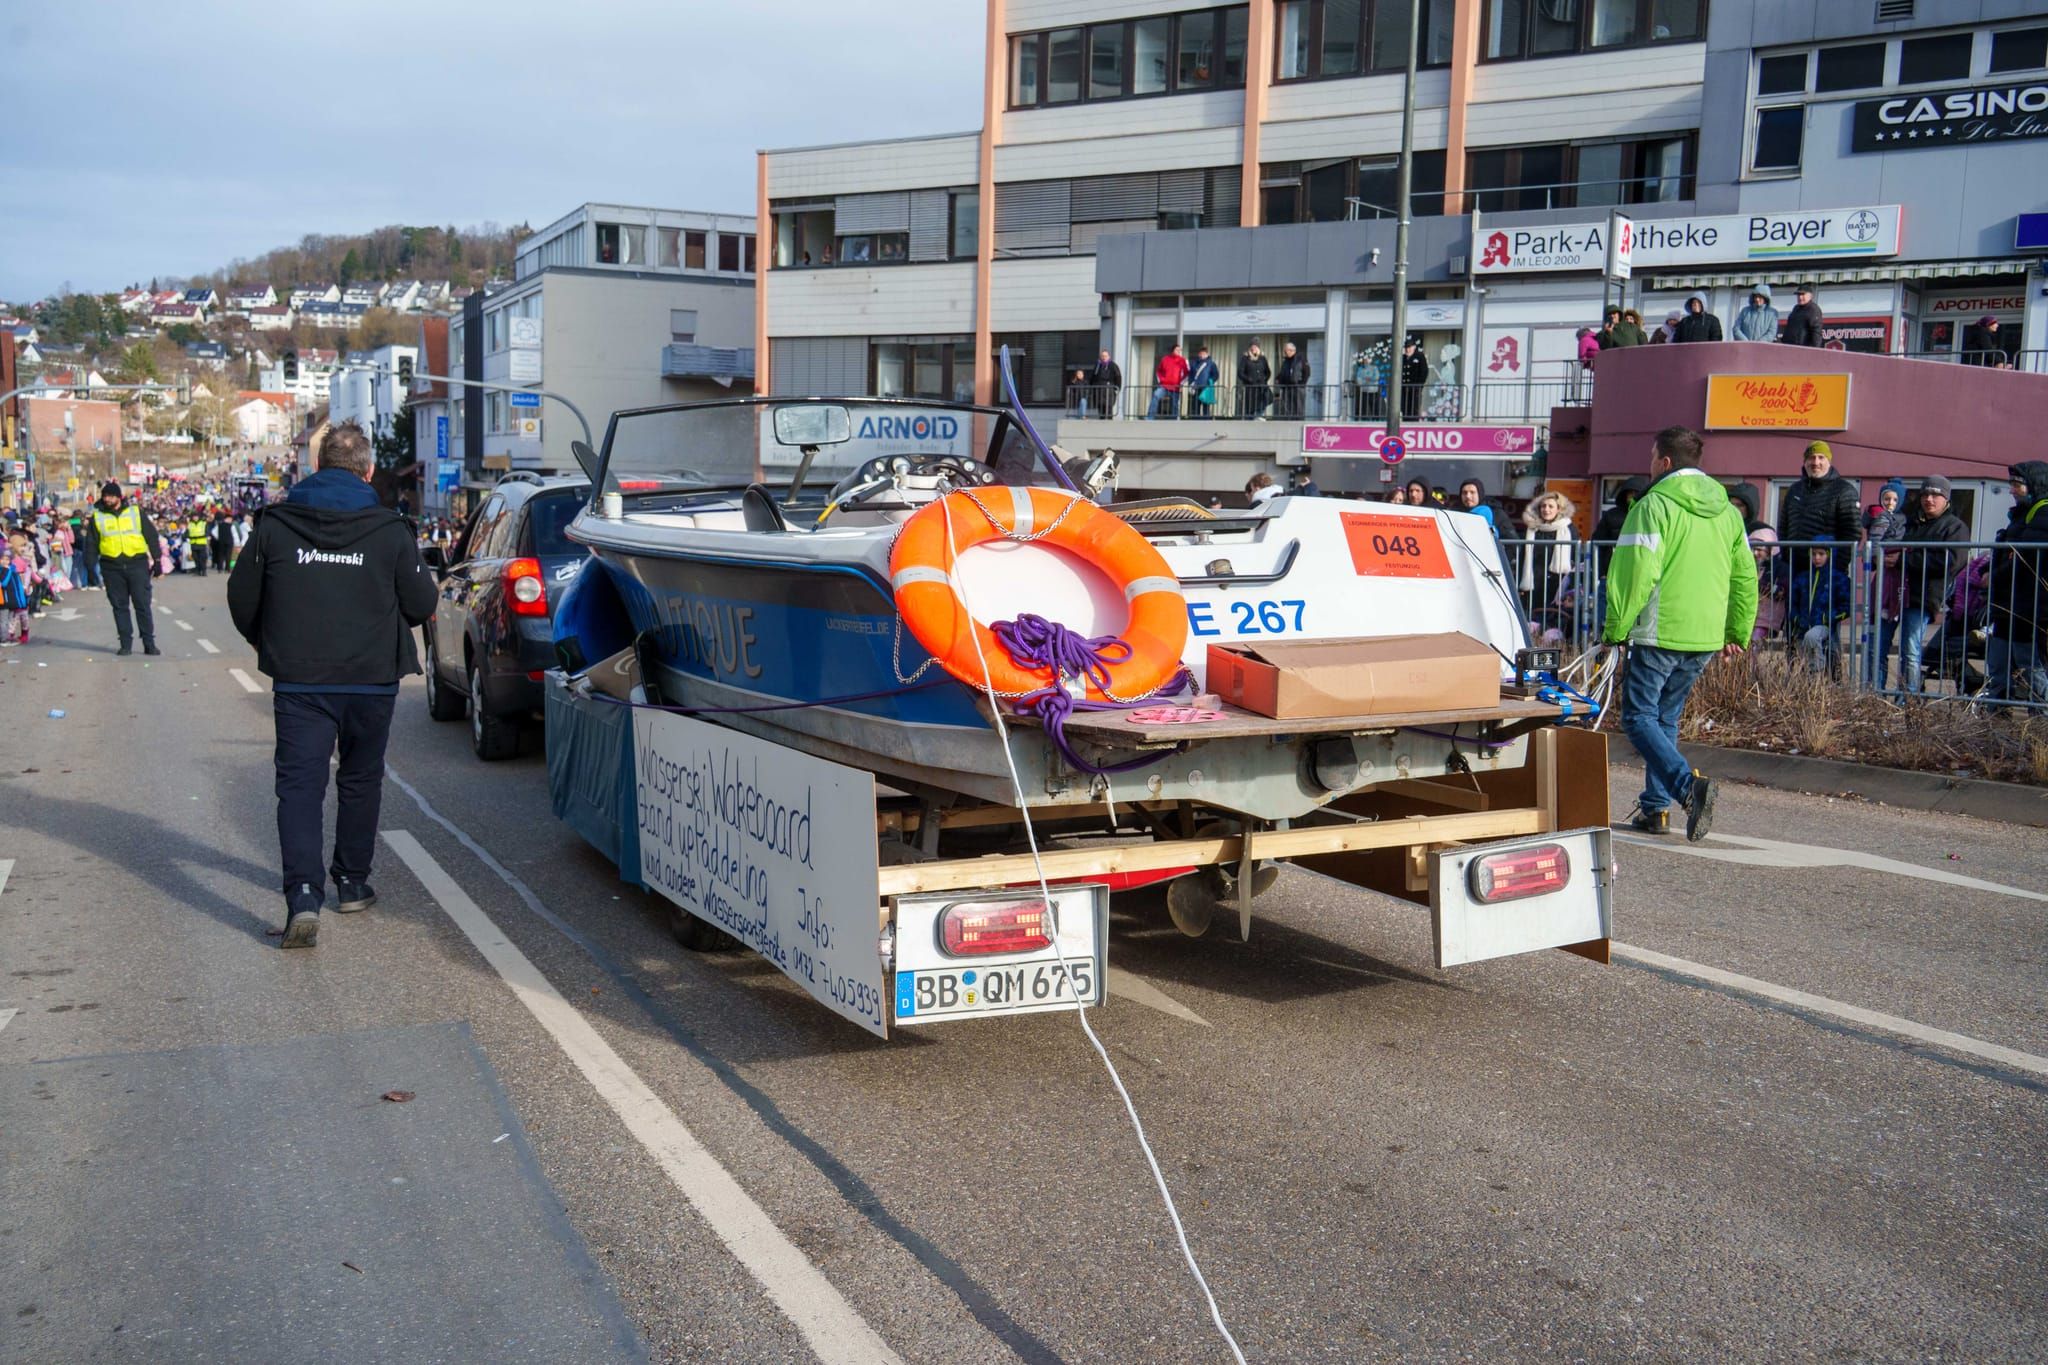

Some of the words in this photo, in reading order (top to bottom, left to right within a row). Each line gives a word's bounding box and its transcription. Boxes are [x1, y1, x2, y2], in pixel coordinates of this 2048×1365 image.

[1879, 87, 2048, 124] CASINO
[1515, 222, 1718, 254] Park-Atheke
[1749, 217, 1831, 246] Bayer
[1847, 222, 1877, 230] BAYER
[1513, 257, 1526, 267] IM
[1529, 255, 1551, 265] LEO
[1554, 254, 1581, 265] 2000
[1933, 297, 2025, 312] APOTHEKE
[1736, 381, 1789, 399] Kebab
[1760, 399, 1788, 409] 2000
[858, 416, 958, 439] ARNOLD
[1369, 431, 1463, 449] CSINO
[297, 548, 364, 566] Wasserski
[1372, 535, 1421, 556] 048
[1186, 602, 1221, 636] E
[1231, 600, 1306, 634] 267
[708, 747, 814, 871] Wakeboard
[638, 783, 675, 856] Stand
[679, 824, 695, 873] up
[695, 808, 768, 928] Paddeling
[644, 847, 662, 885] und
[665, 862, 698, 904] andere
[797, 888, 835, 950] Info:
[793, 947, 815, 983] 0172
[820, 960, 881, 1025] 7405939
[916, 974, 959, 1010] BB
[984, 969, 1024, 1004] QM
[1032, 963, 1091, 1000] 675
[902, 998, 910, 1008] D
